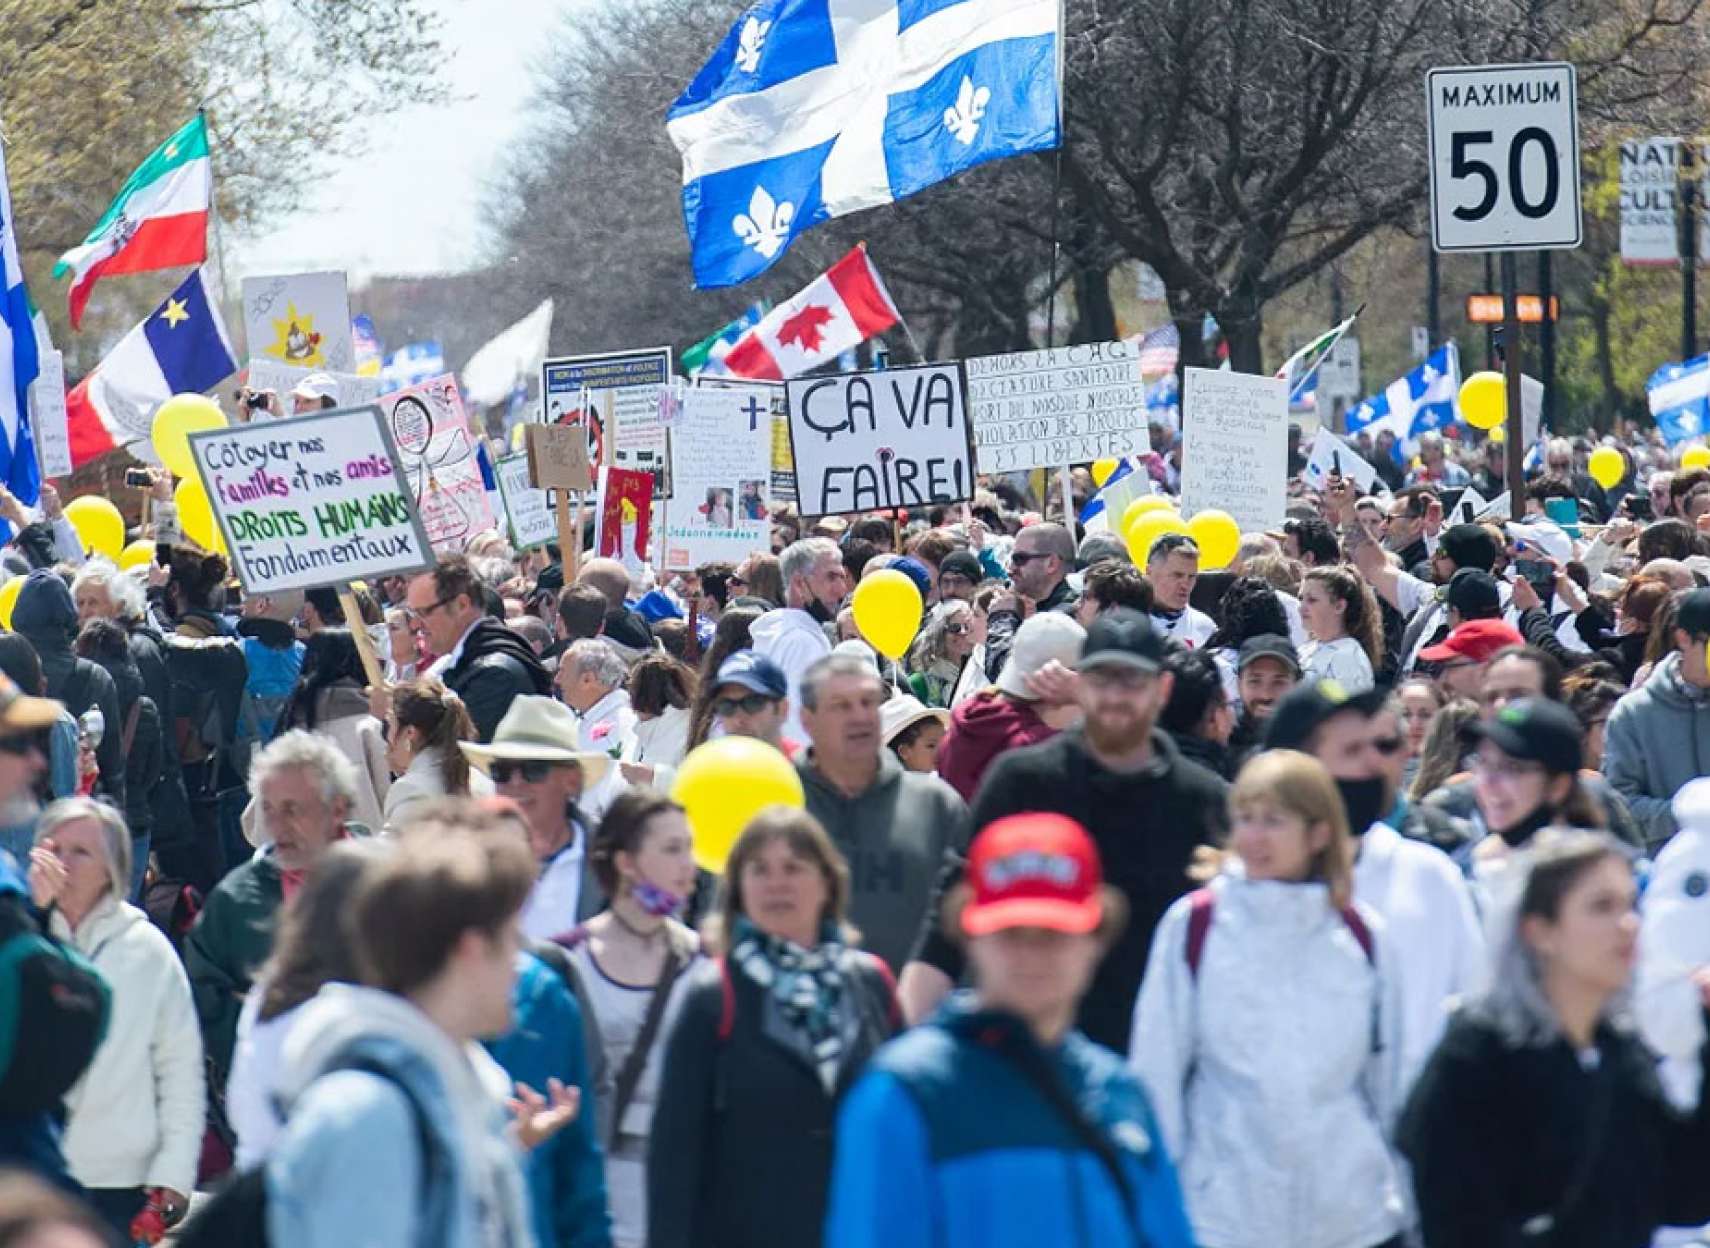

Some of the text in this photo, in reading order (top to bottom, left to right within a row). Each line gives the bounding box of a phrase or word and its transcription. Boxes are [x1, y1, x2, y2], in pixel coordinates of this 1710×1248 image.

[1442, 81, 1561, 107] MAXIMUM
[1451, 126, 1560, 221] 50
[801, 377, 876, 442] ÇA
[892, 373, 954, 429] VA
[299, 437, 325, 454] nos
[292, 462, 309, 491] et
[313, 469, 343, 488] nos
[345, 454, 392, 480] amis
[240, 533, 413, 583] Fondamentaux
